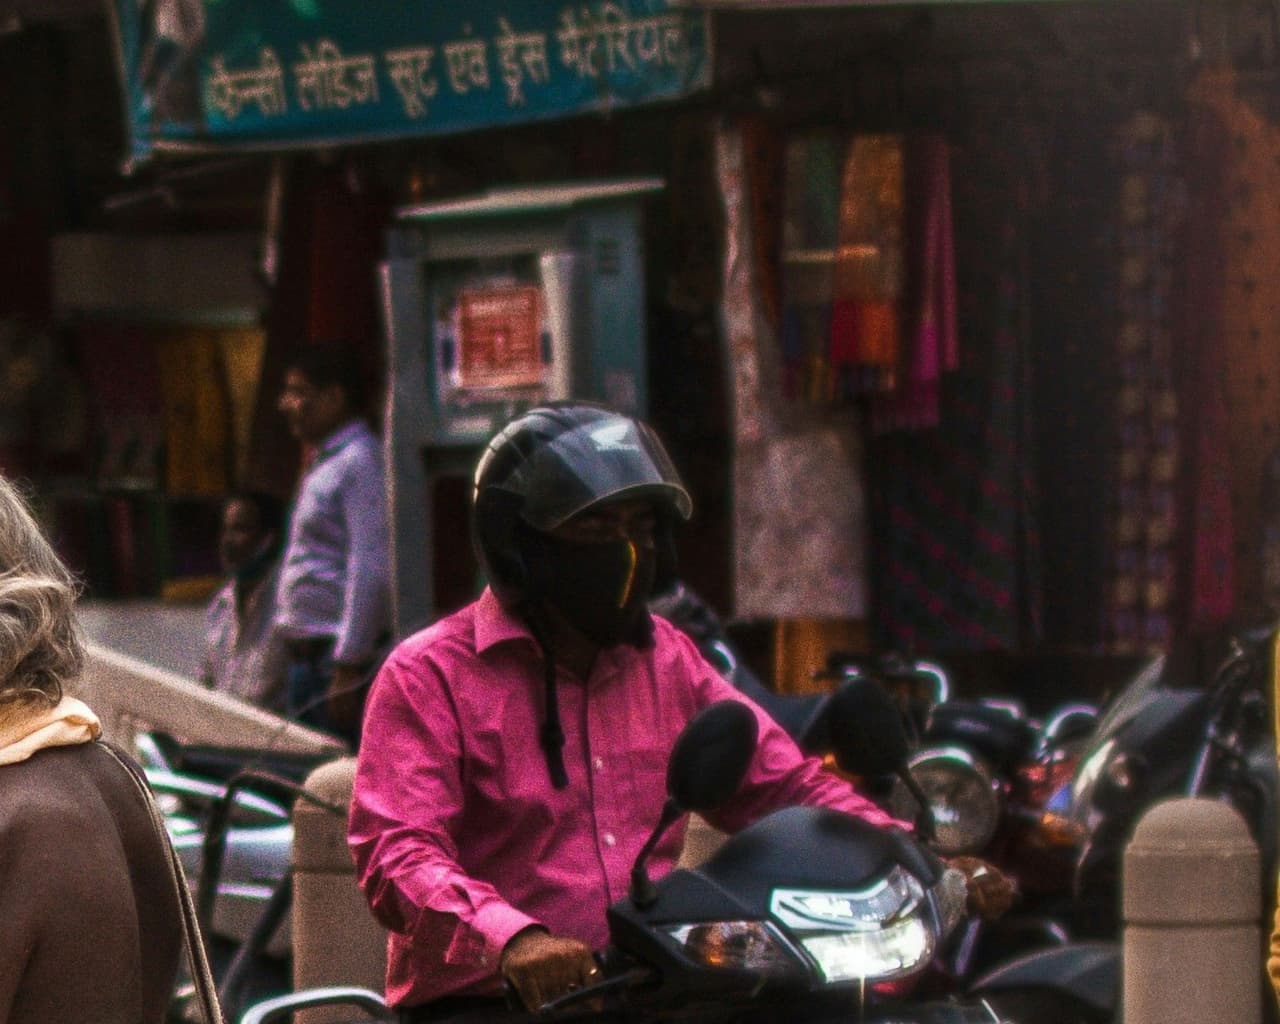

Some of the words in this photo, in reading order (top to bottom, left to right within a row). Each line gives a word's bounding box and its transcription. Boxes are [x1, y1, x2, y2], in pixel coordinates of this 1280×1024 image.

[385, 45, 437, 119] सूट
[443, 22, 490, 94] एवं
[496, 16, 550, 106] ड्रेस
